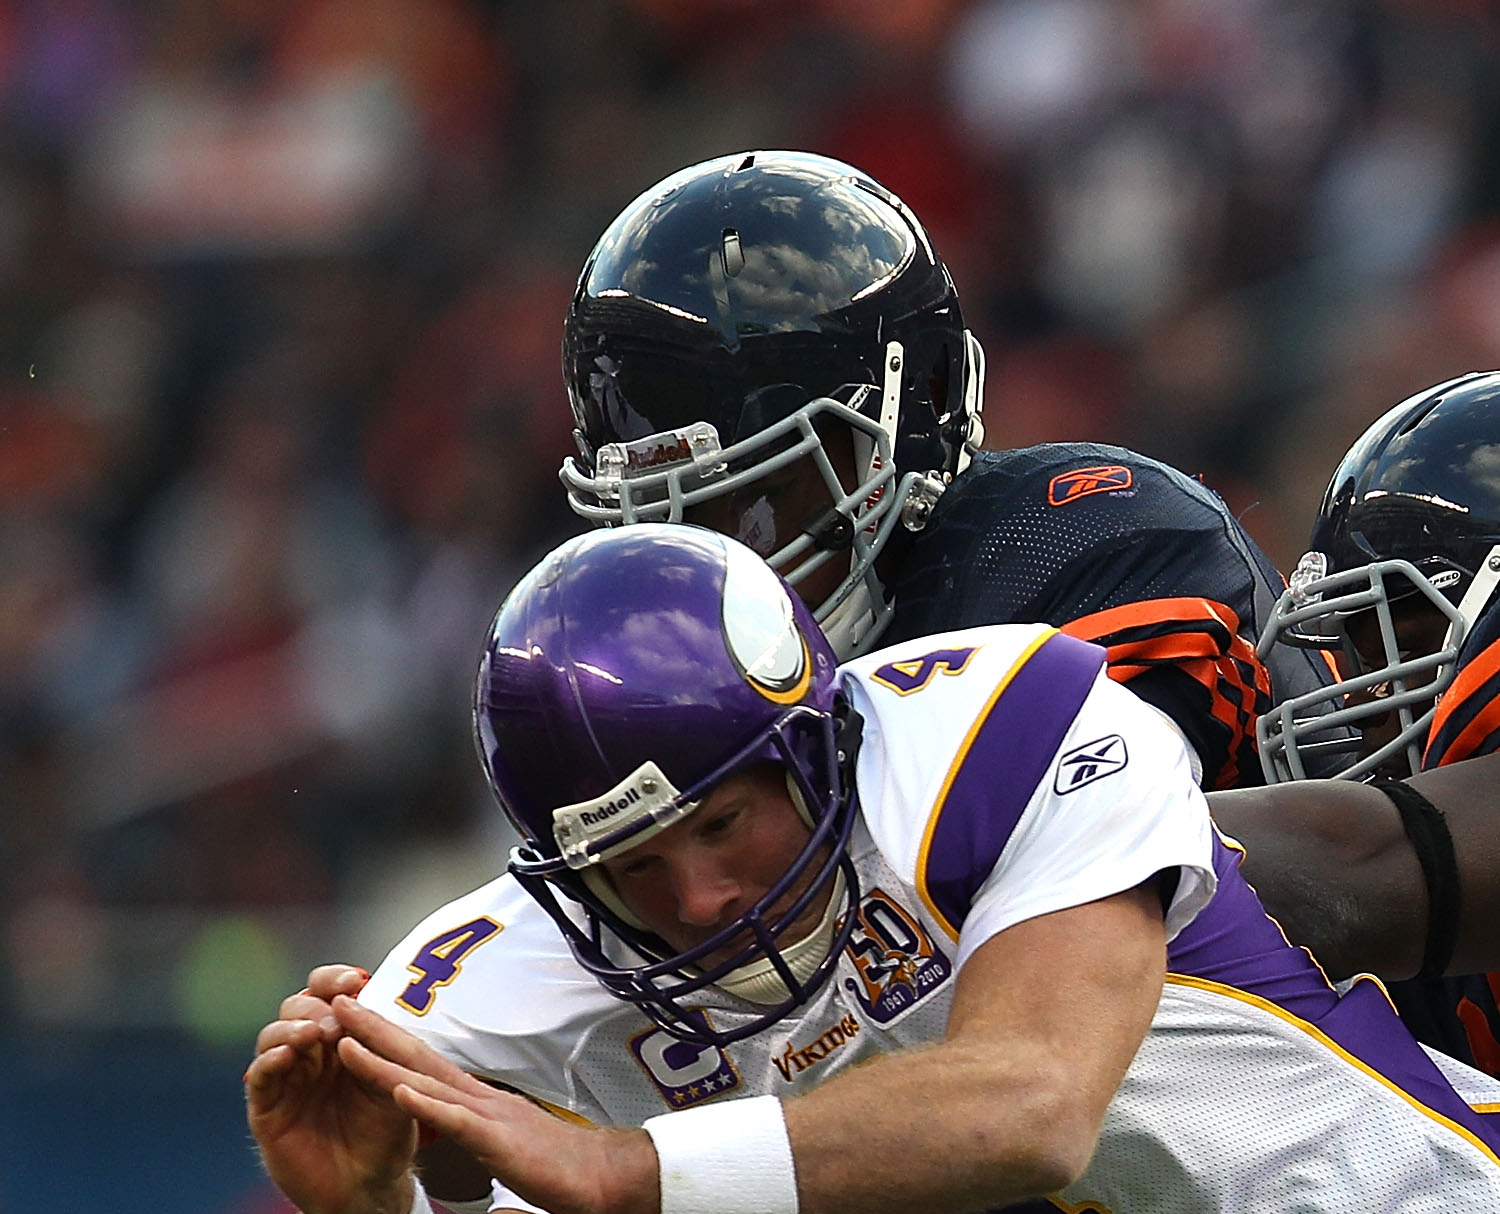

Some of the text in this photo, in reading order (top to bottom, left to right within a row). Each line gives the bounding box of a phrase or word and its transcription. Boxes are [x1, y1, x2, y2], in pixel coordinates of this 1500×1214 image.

[1429, 572, 1460, 586] PEED
[869, 645, 984, 697] 4
[580, 787, 641, 826] Riddell
[395, 914, 505, 1018] 4
[882, 963, 944, 1012] 1961 2010
[640, 1018, 721, 1089] C
